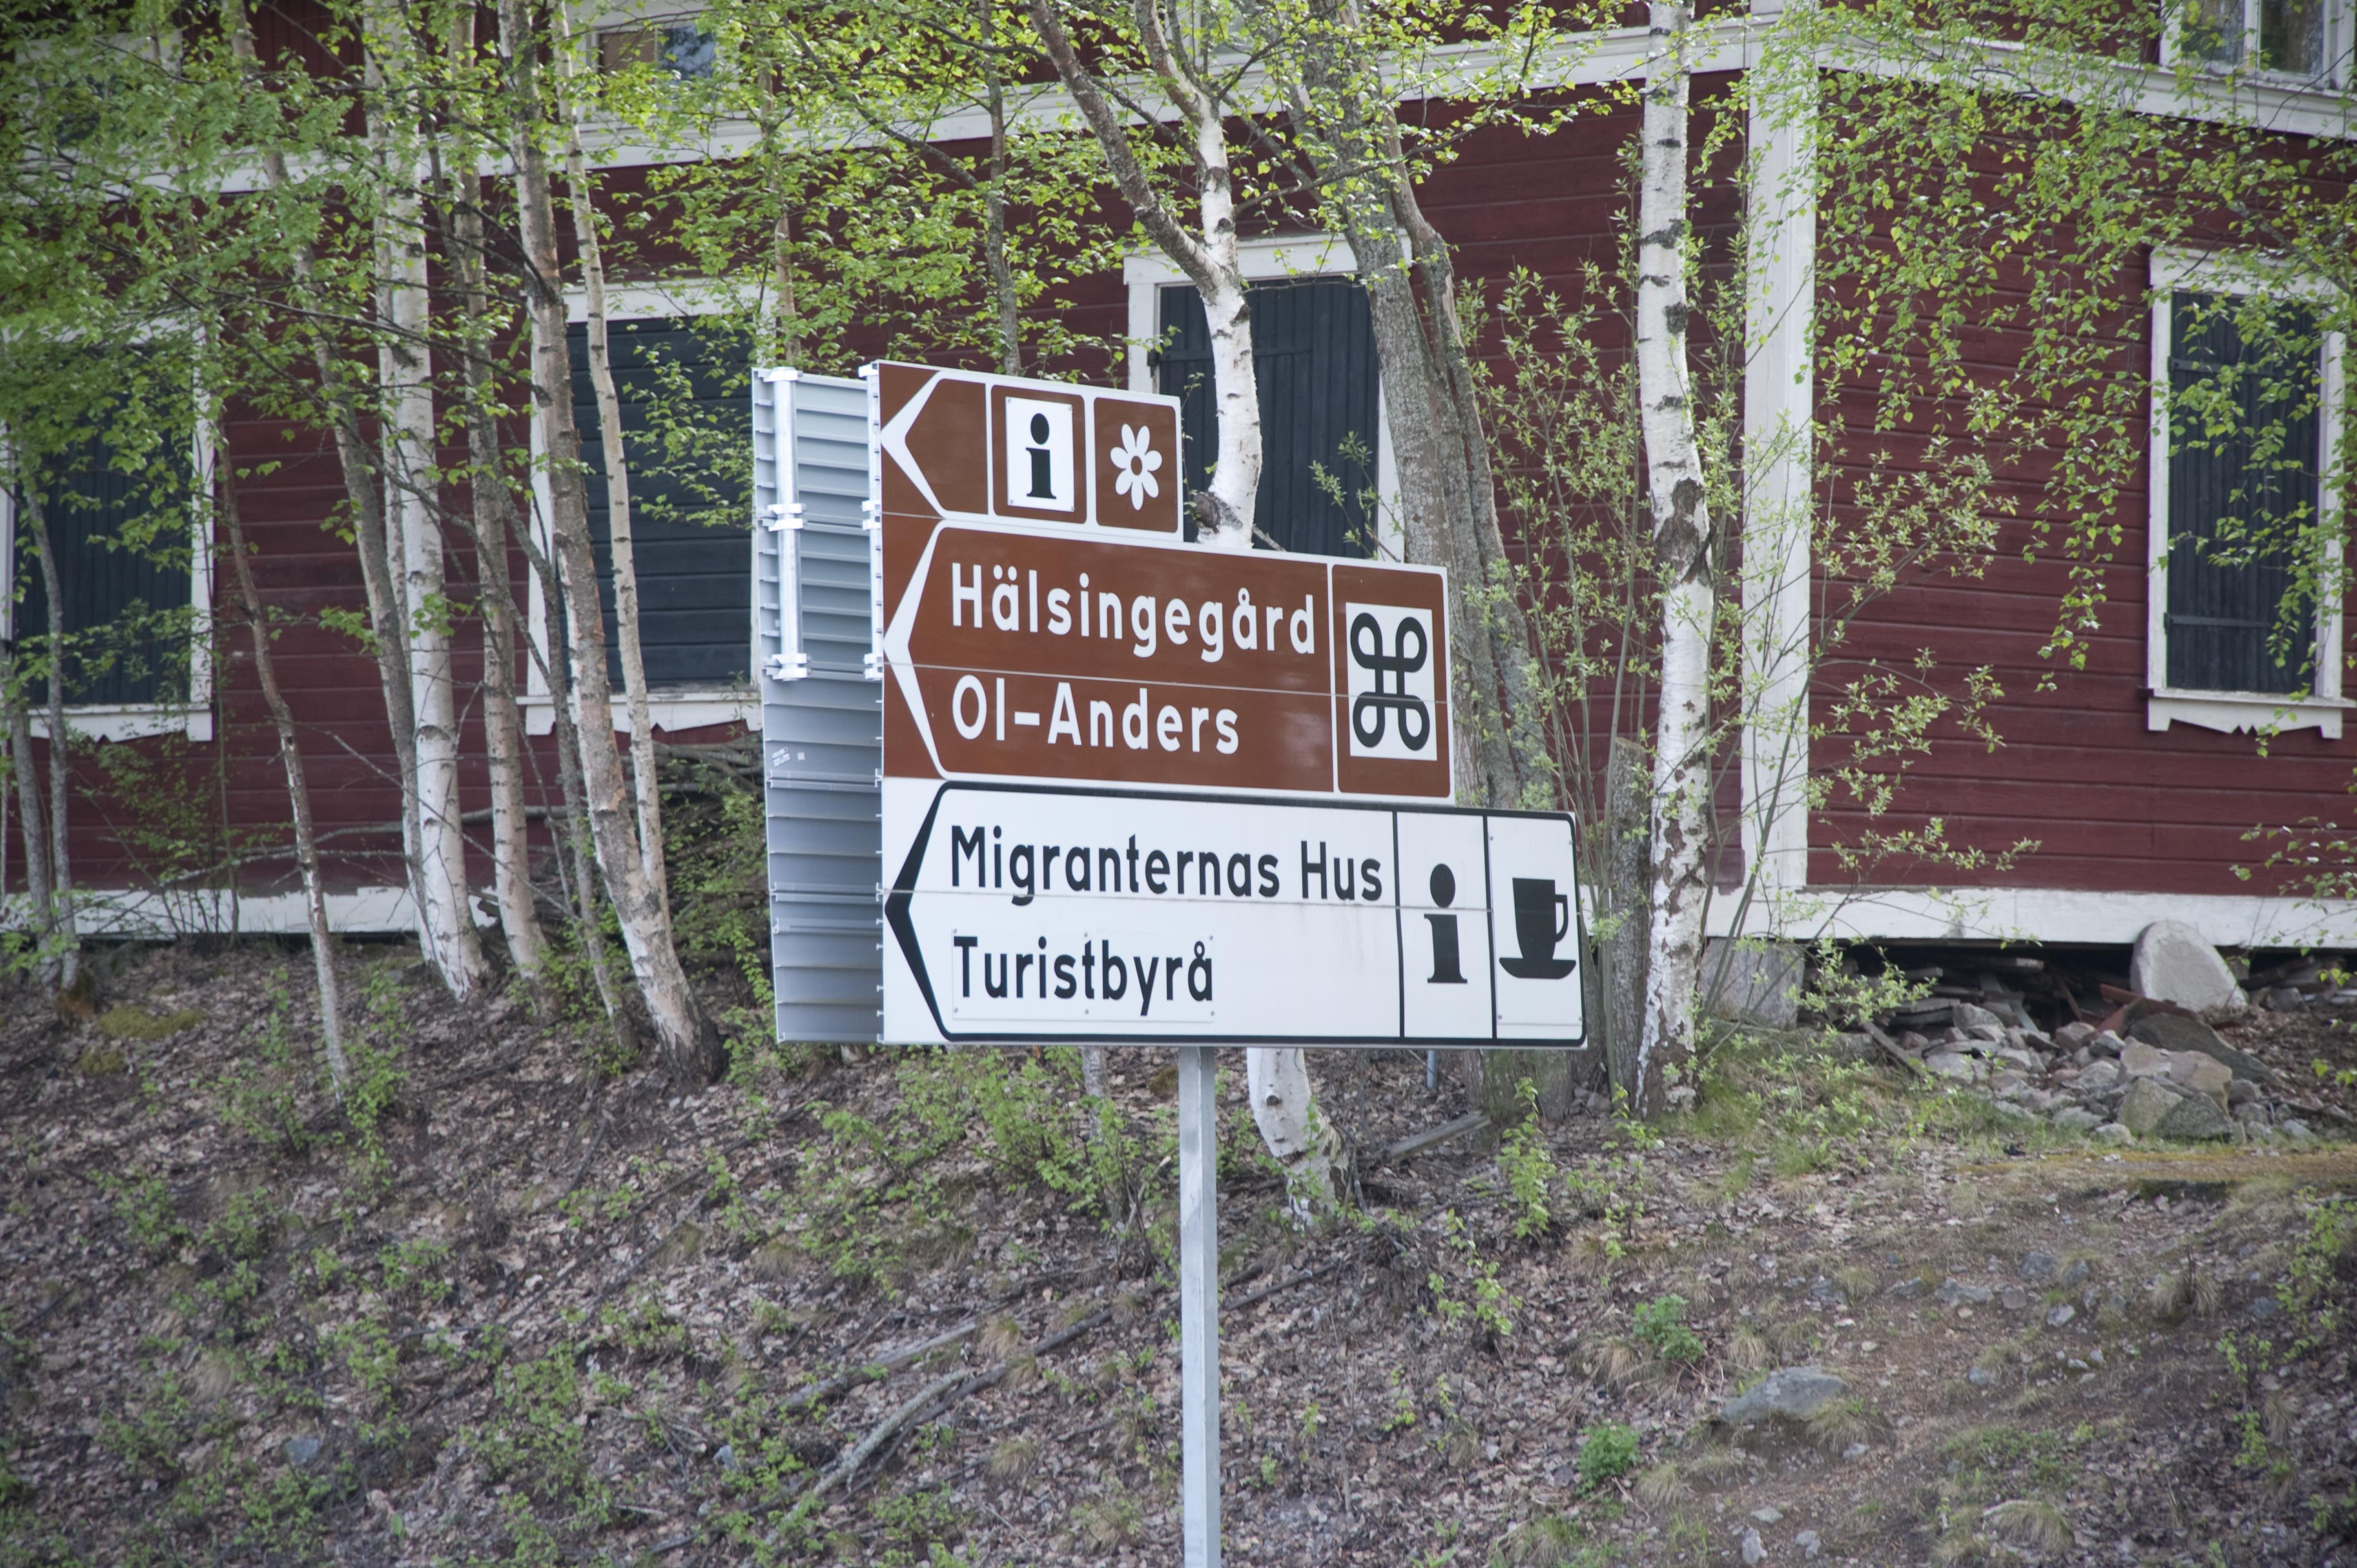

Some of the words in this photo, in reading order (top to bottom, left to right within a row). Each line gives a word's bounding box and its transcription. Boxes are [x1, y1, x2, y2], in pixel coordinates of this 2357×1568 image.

[952, 562, 1315, 663] Hälsingegård
[952, 674, 1239, 754] Ol-Anders
[951, 825, 1280, 906] Migranternas
[1301, 840, 1383, 901] Hus
[954, 936, 1213, 1016] Turistbyrå
